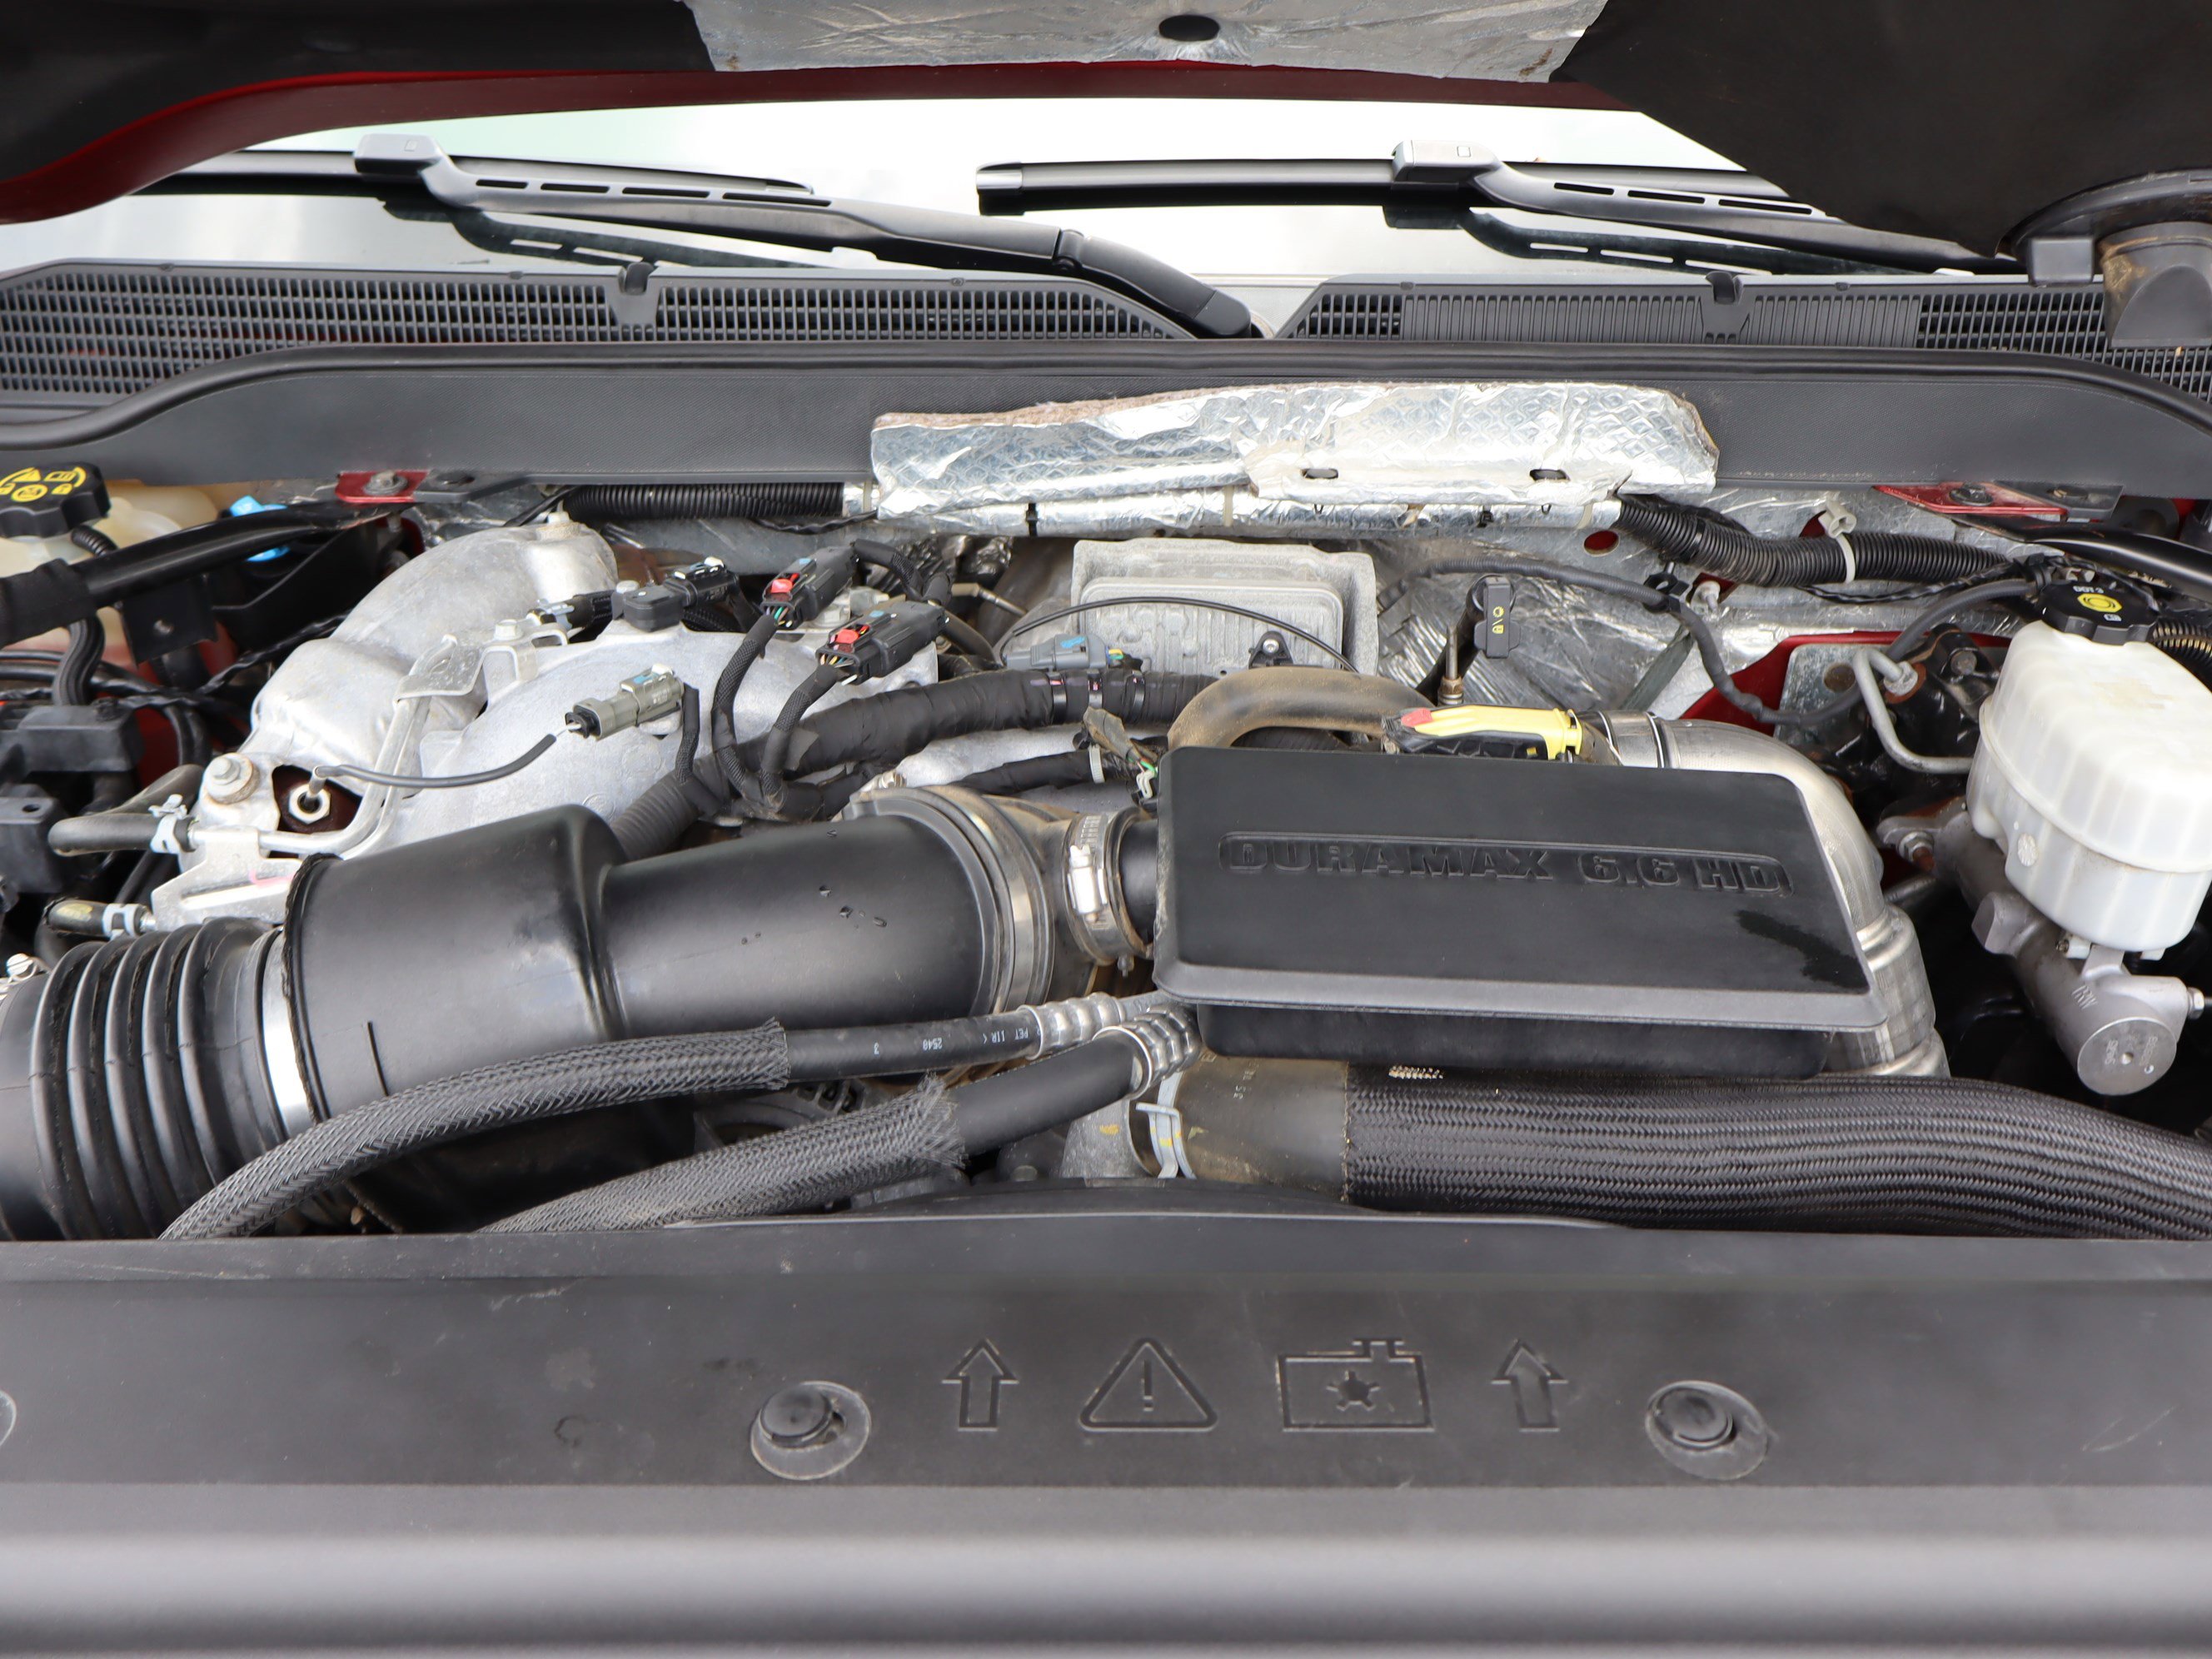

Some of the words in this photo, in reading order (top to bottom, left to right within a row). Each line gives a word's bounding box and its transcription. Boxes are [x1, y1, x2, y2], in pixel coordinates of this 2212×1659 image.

[1228, 841, 1554, 879] DURAMAX
[1578, 853, 1681, 886] 6.6
[1692, 856, 1782, 892] HD
[1014, 1027, 1029, 1041] PET
